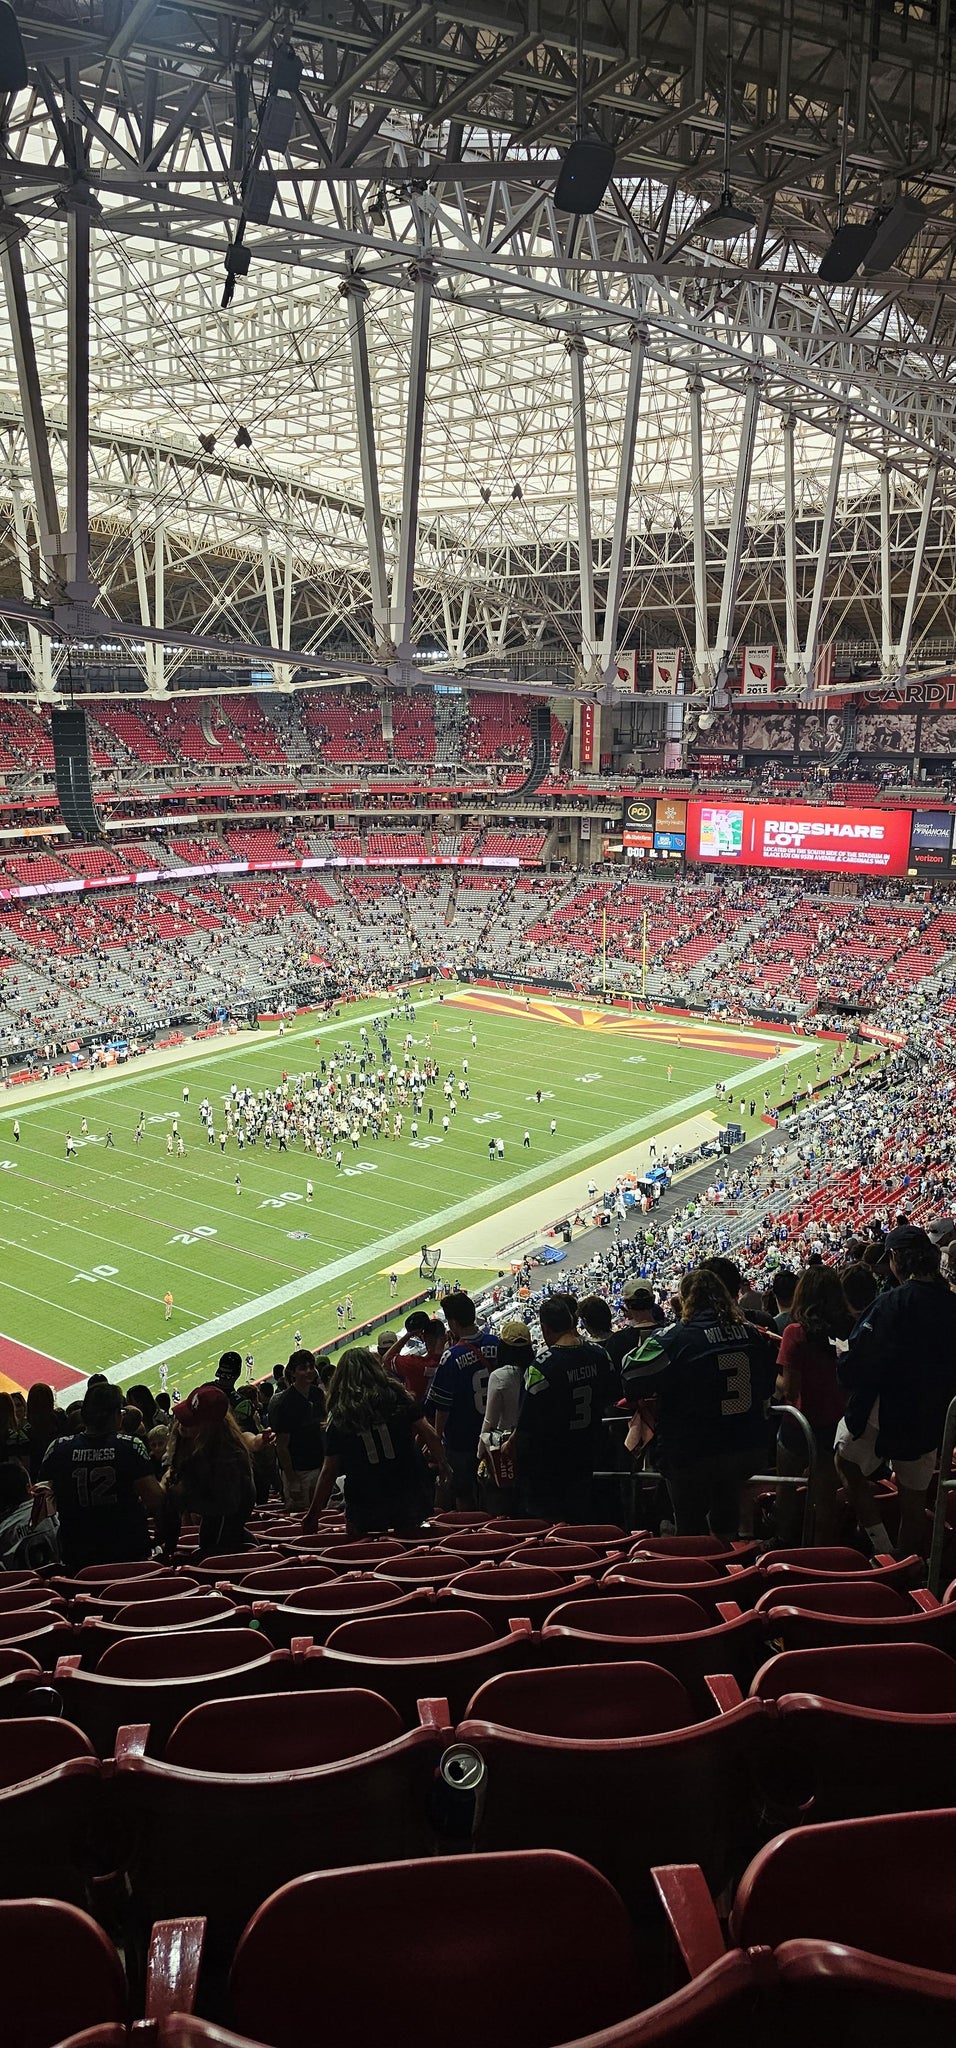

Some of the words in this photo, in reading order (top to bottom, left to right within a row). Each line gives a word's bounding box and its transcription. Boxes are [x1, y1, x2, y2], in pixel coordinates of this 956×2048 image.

[631, 807, 648, 816] PCL
[764, 820, 885, 839] RIDESHARE
[763, 832, 805, 846] LOT
[843, 856, 874, 864] CARDINALS
[915, 855, 943, 863] verizon
[473, 1111, 503, 1124] 40
[409, 1136, 444, 1149] 50
[343, 1162, 379, 1177] 40
[262, 1192, 304, 1208] 30
[172, 1225, 218, 1245] 20
[74, 1264, 119, 1283] 10
[704, 1325, 749, 1344] WILSON
[567, 1364, 599, 1384] WILSON
[717, 1351, 753, 1416] 3
[570, 1385, 593, 1431] 3
[357, 1421, 396, 1465] 11
[72, 1447, 116, 1462] CUTENESS
[71, 1465, 118, 1507] 12
